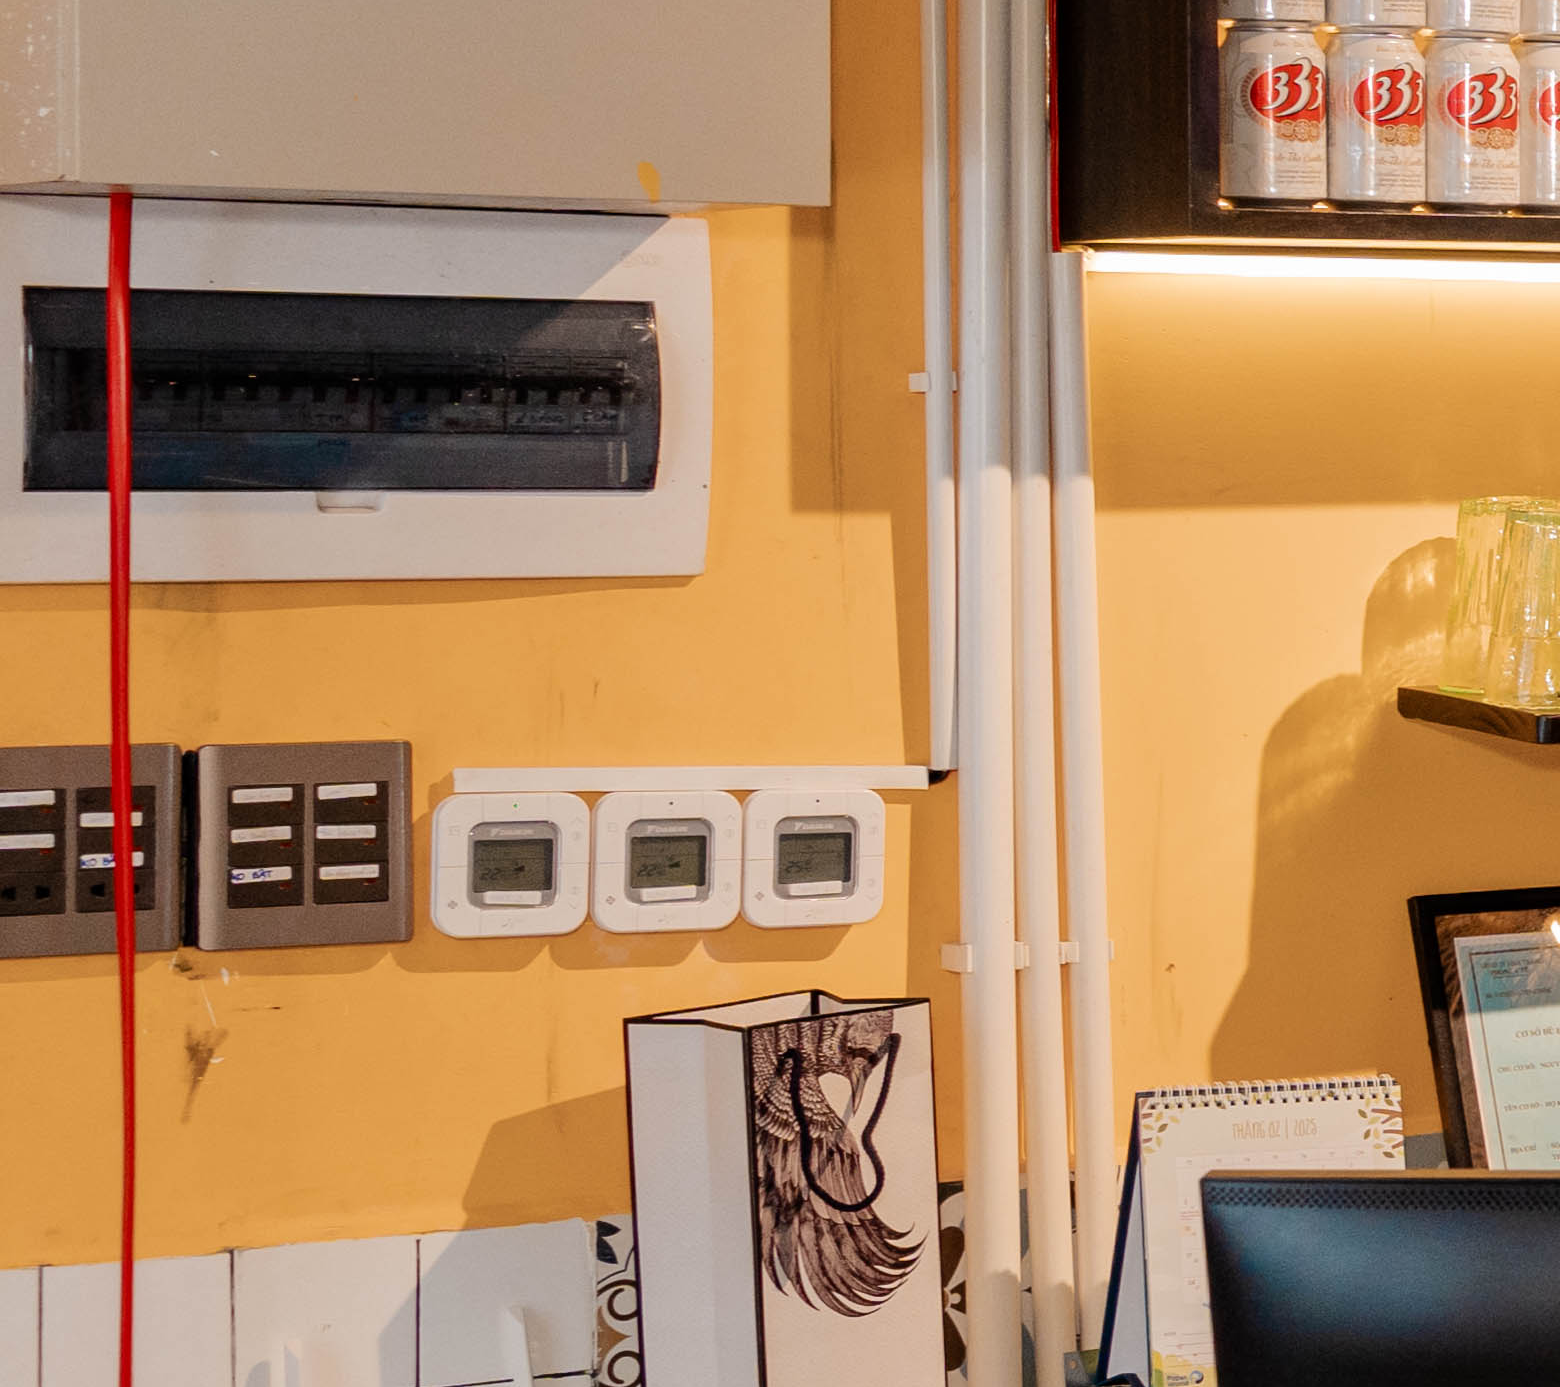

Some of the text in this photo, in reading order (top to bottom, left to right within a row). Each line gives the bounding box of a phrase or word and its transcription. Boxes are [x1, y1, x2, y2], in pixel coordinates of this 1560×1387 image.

[1261, 57, 1322, 117] 333
[1366, 63, 1423, 121] 333
[1457, 66, 1517, 125] 333
